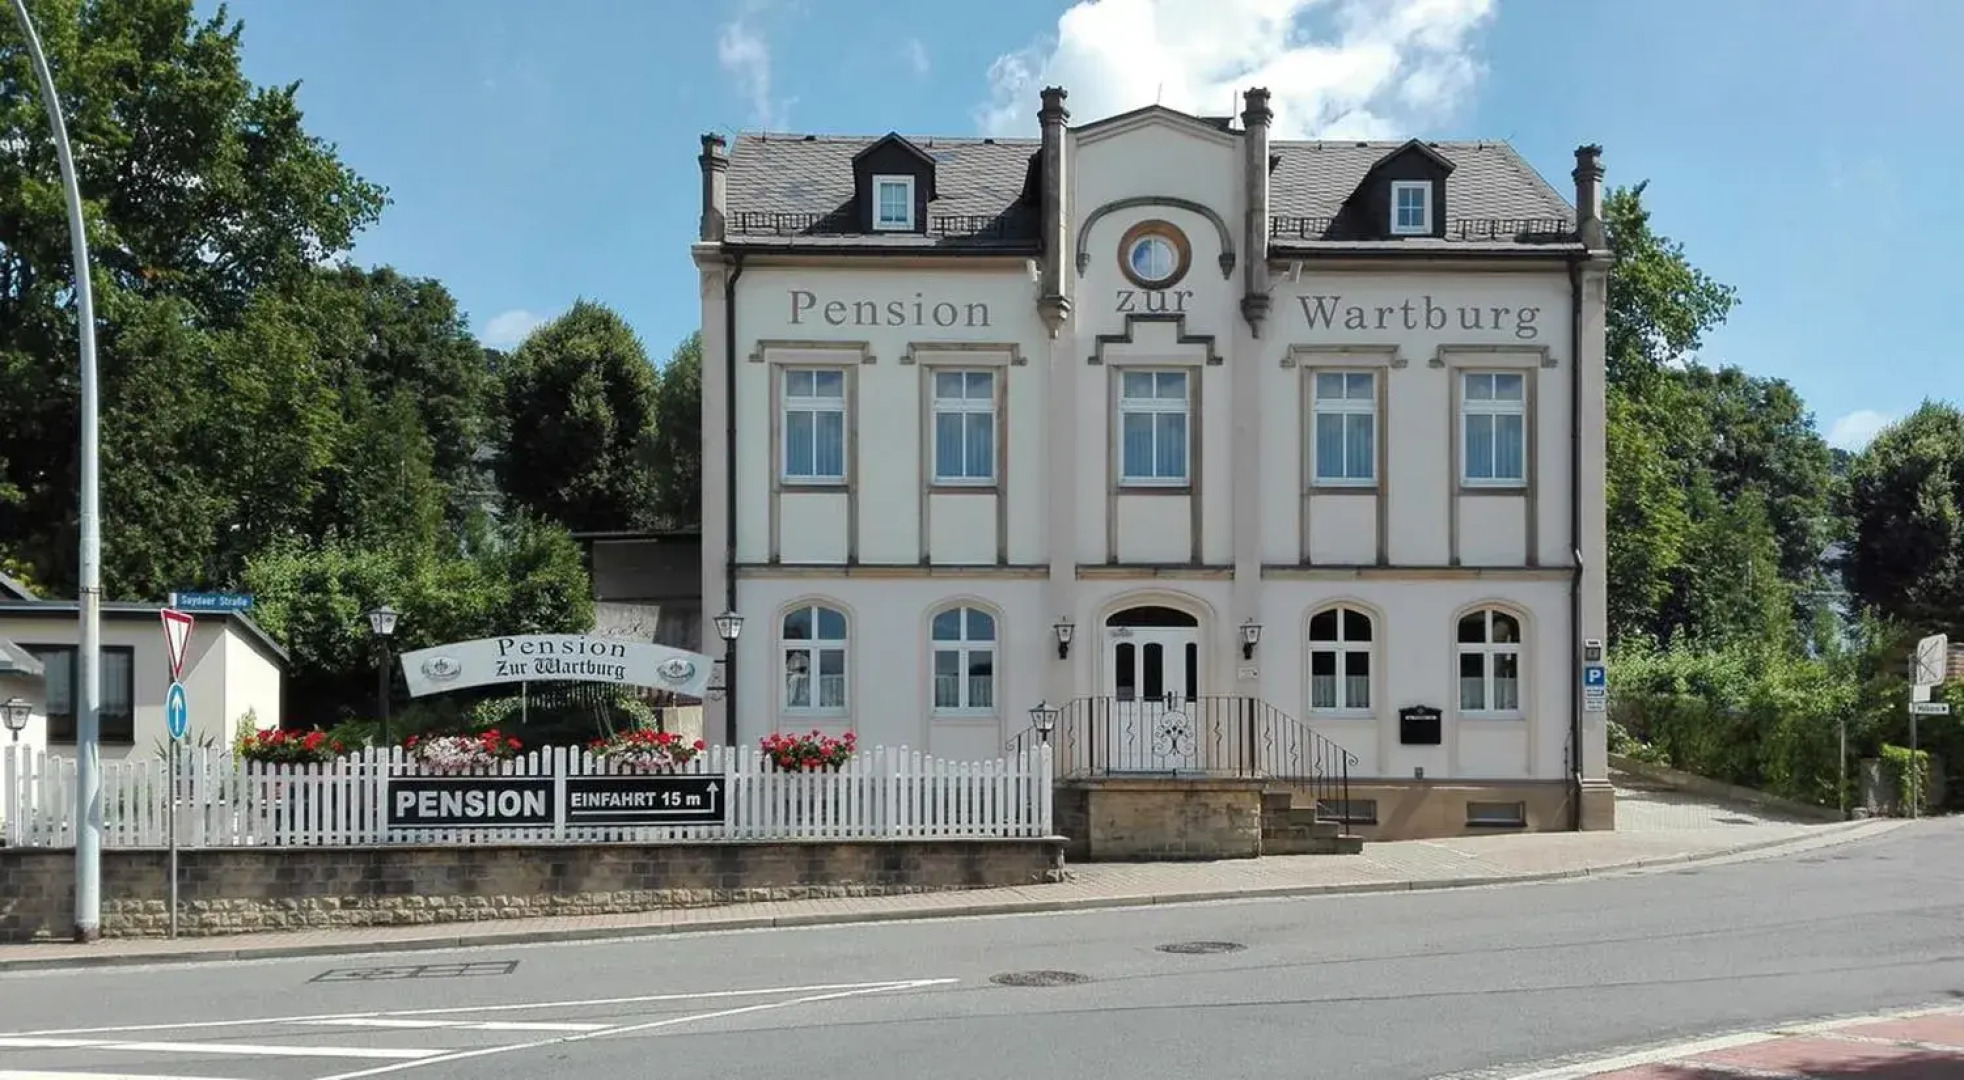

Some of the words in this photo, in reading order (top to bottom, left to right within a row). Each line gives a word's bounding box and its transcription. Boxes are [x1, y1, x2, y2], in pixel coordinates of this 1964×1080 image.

[787, 290, 990, 327] Pension
[1116, 290, 1193, 312] zur
[1297, 296, 1541, 339] Wartburg
[498, 636, 627, 657] Pension
[496, 659, 527, 676] Zur
[534, 657, 627, 679] Wartburg
[1589, 670, 1601, 682] P
[396, 790, 546, 818] PENSION
[571, 791, 657, 808] EINFAHRT
[661, 791, 682, 806] 15
[686, 794, 701, 806] m
